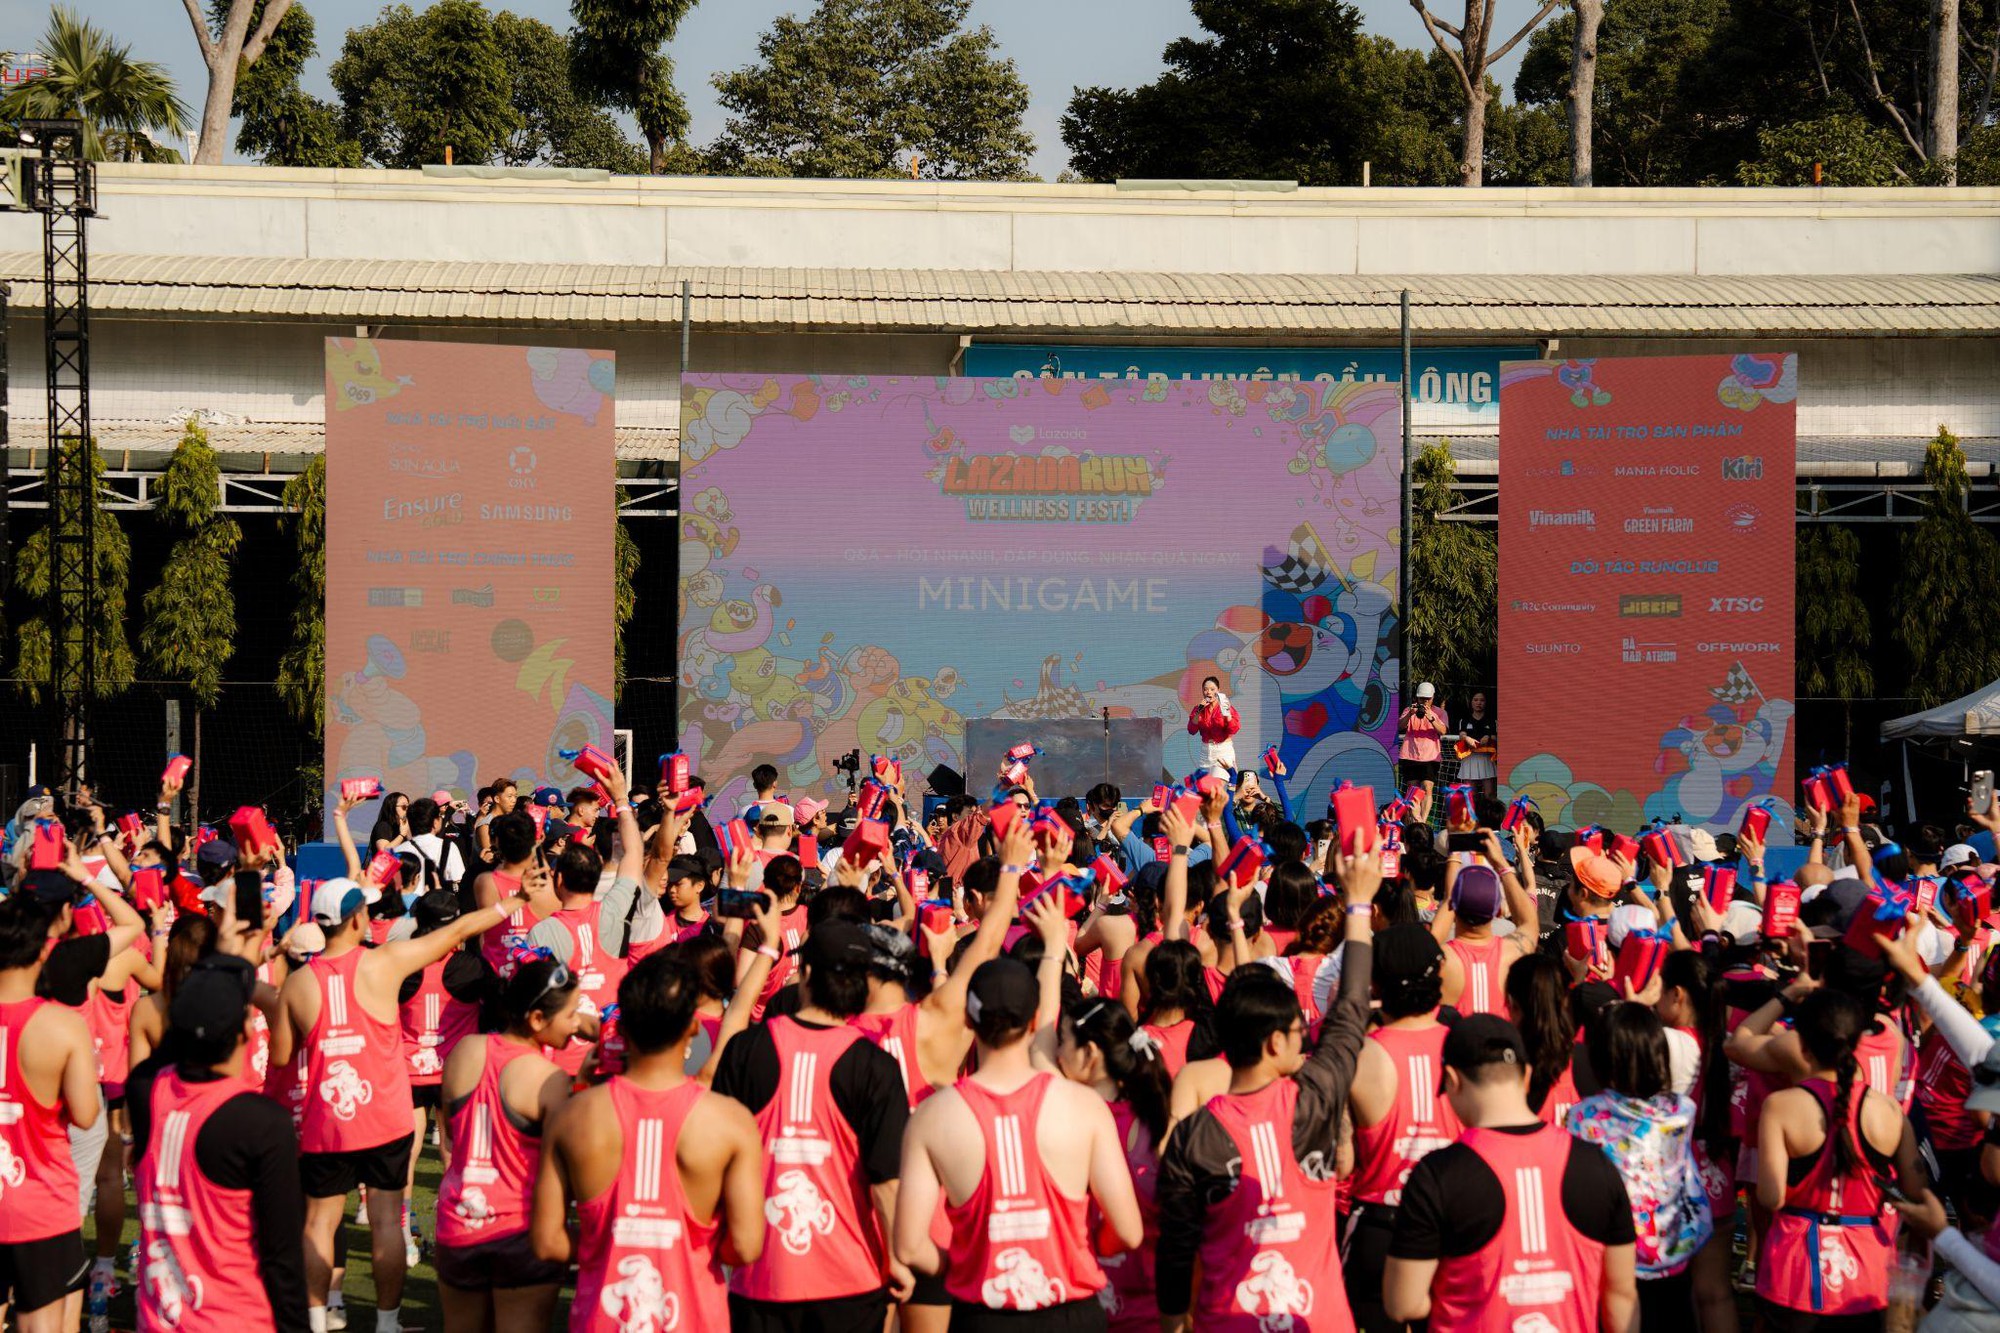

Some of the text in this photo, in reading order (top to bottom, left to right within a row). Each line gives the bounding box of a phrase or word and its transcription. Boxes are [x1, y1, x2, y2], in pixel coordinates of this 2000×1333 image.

[1411, 366, 1492, 404] ÔNG
[1039, 427, 1087, 440] Lazada
[1615, 465, 1700, 476] MANIA HOLIC
[1722, 456, 1763, 481] Kiri
[383, 492, 464, 520] Ensure
[480, 504, 573, 522] SAMSUNG
[968, 499, 1128, 522] WELLNESS FEST!
[1529, 509, 1596, 525] Vinamilk
[1624, 518, 1693, 533] GREEN FARM
[844, 549, 879, 562] Q&A
[1639, 561, 1719, 574] RUNCLUB
[918, 576, 1168, 612] MINIGAME
[1542, 601, 1595, 613] Community
[1708, 597, 1764, 613] XTSC
[1526, 643, 1581, 654] SUUNTO
[1697, 641, 1780, 653] OFFWORK
